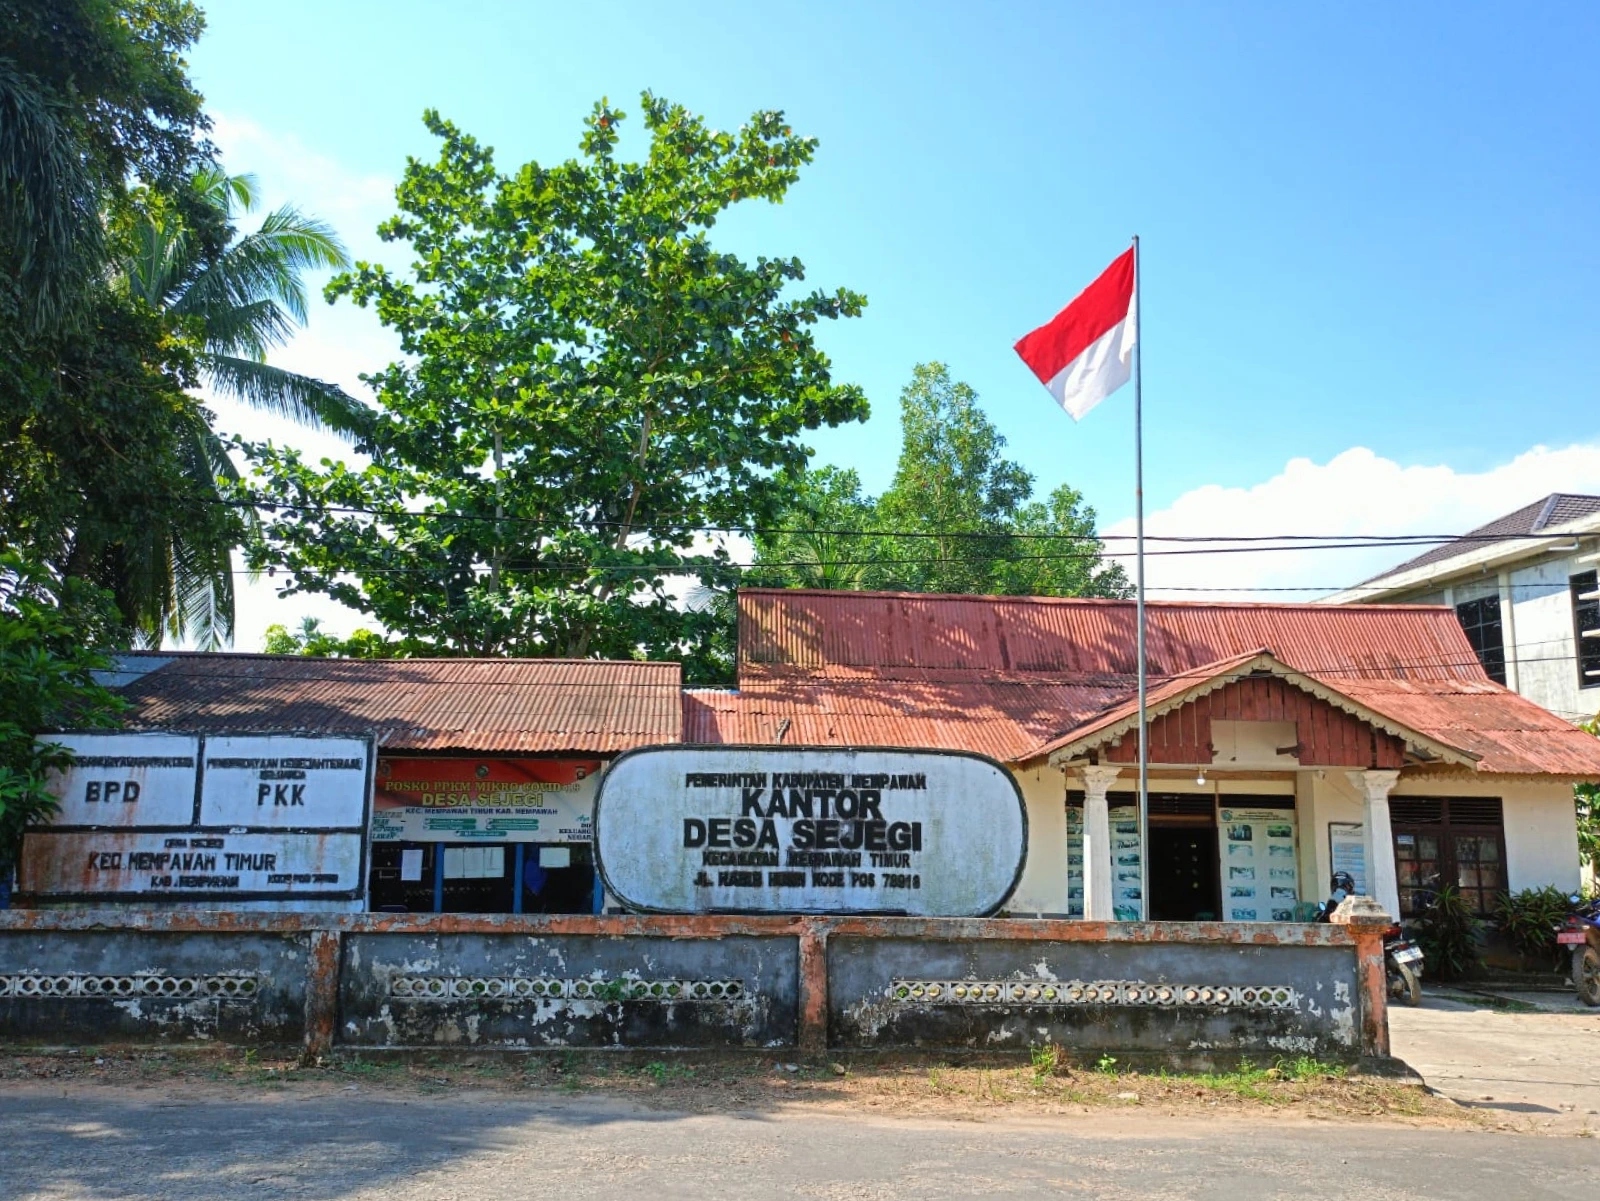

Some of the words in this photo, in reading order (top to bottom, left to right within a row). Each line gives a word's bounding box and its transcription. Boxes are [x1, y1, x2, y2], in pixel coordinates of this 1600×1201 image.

[85, 781, 141, 802] BPD
[257, 783, 306, 806] PKK
[385, 781, 430, 792] POSKO
[434, 782, 471, 792] PPKM
[475, 782, 519, 792] MIKRO
[422, 793, 472, 807] DESA
[476, 793, 544, 808] SEJEGI
[741, 788, 884, 820] KANTOR
[683, 818, 780, 849] DESA
[791, 819, 922, 851] SEJEGI
[128, 852, 217, 871] MEMPAWAH
[224, 852, 277, 871] TIMUR
[869, 852, 911, 868] TIMUR
[812, 871, 845, 889] KODE
[851, 872, 876, 889] POS
